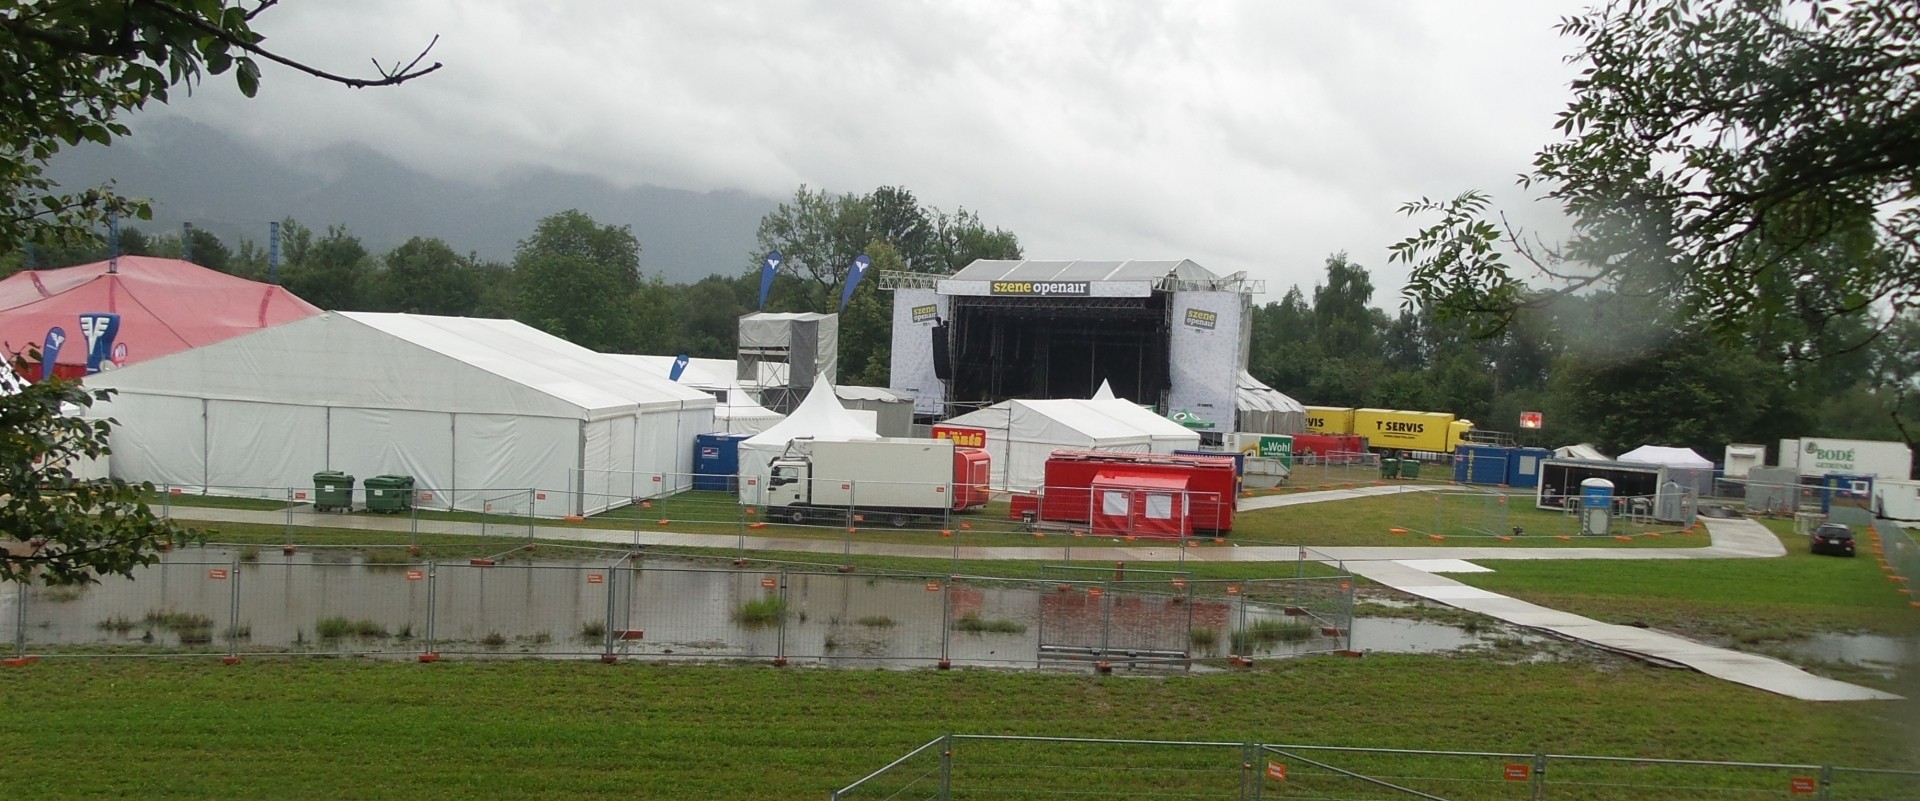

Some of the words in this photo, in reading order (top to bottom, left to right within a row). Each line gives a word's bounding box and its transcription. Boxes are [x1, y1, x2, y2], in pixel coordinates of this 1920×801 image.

[994, 282, 1031, 293] szene
[1033, 282, 1086, 295] openair
[913, 306, 936, 315] szene
[1188, 310, 1215, 321] szene
[913, 312, 936, 321] openair
[1186, 318, 1214, 327] openair
[1376, 420, 1383, 431] T
[1385, 421, 1424, 433] SERVIS
[1268, 441, 1291, 453] Wohl
[1816, 448, 1855, 462] BODÉ
